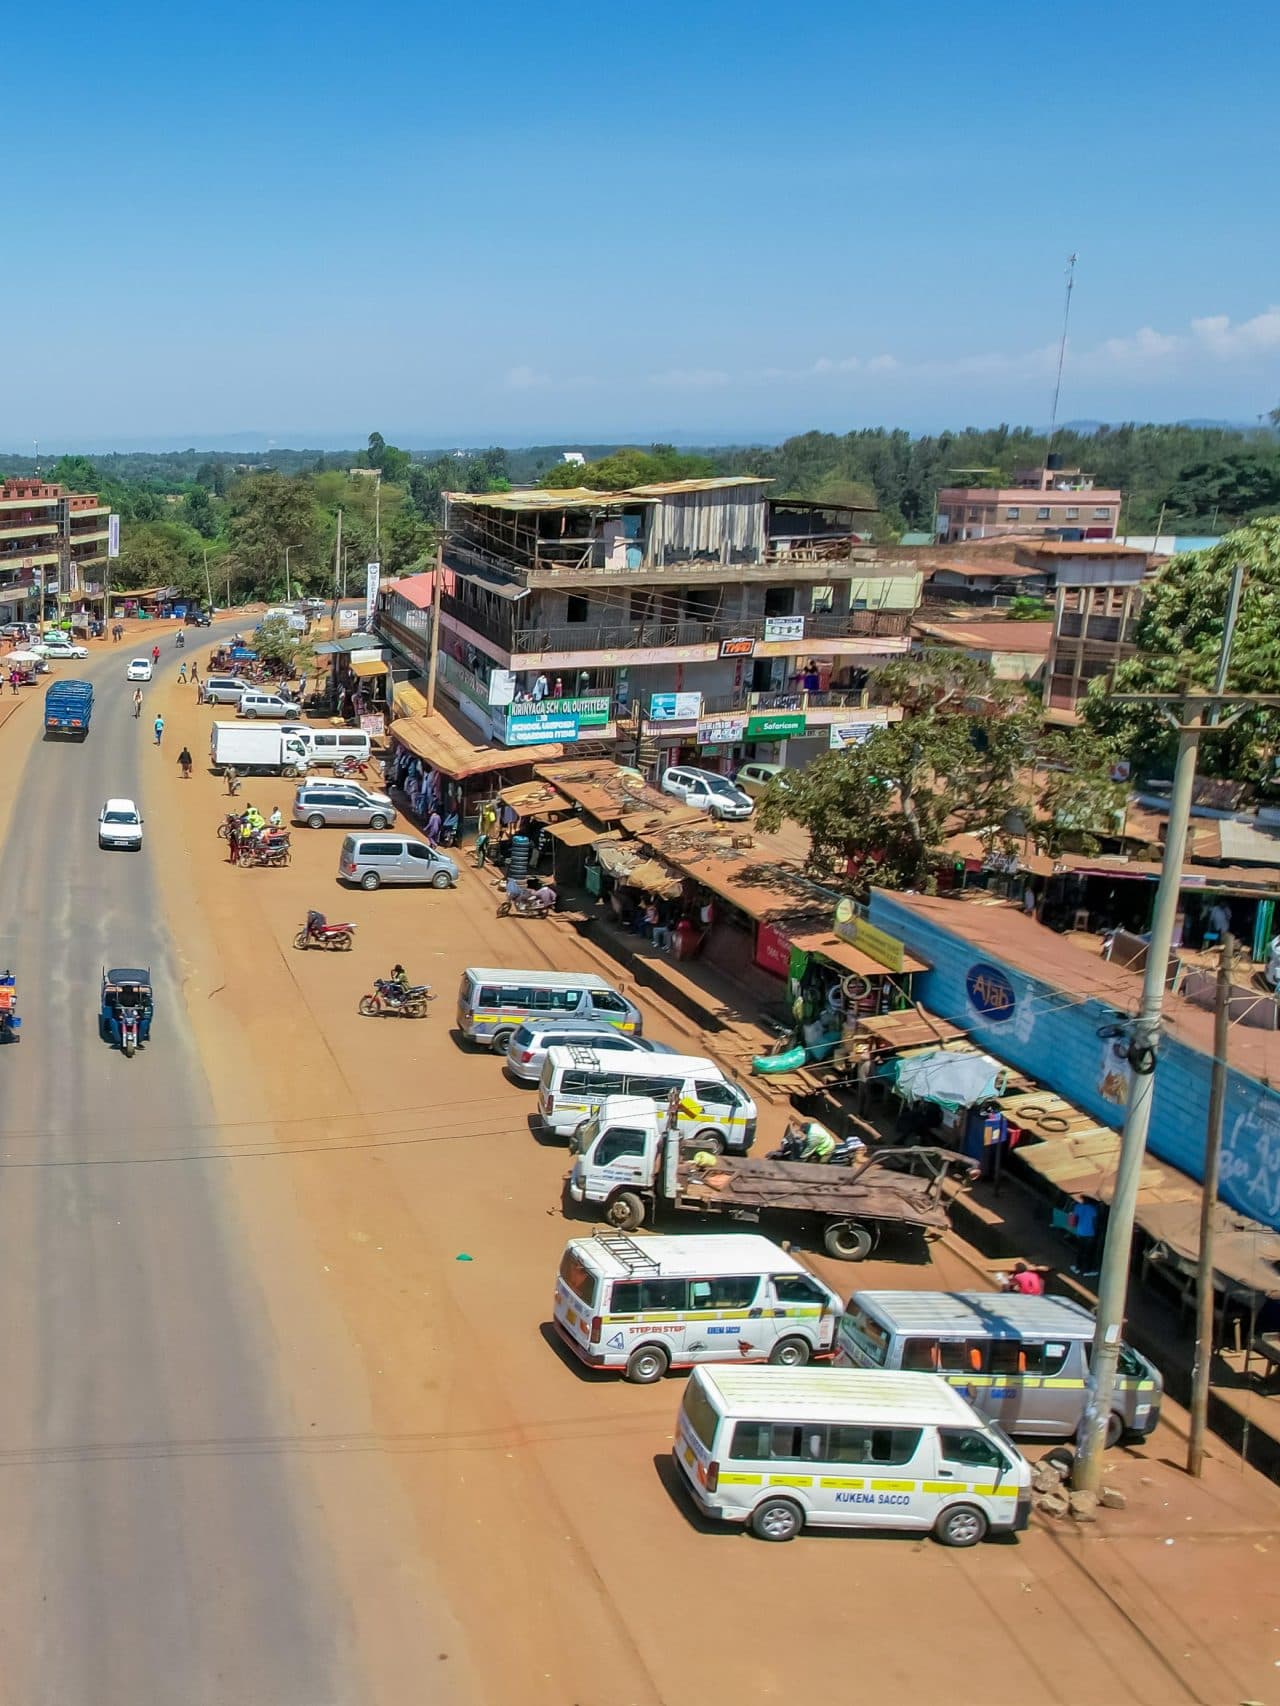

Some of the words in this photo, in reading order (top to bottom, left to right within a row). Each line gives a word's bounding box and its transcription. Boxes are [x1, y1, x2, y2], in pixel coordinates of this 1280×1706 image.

[511, 702, 544, 716] KIRINYAGA
[546, 700, 571, 714] SCHOL
[572, 698, 608, 714] OUTFITTERS
[763, 722, 799, 730] Safaricom
[629, 1326, 650, 1334] STEP
[663, 1325, 686, 1333] STEP
[835, 1492, 875, 1504] KUKENA
[878, 1494, 910, 1506] SACCO
